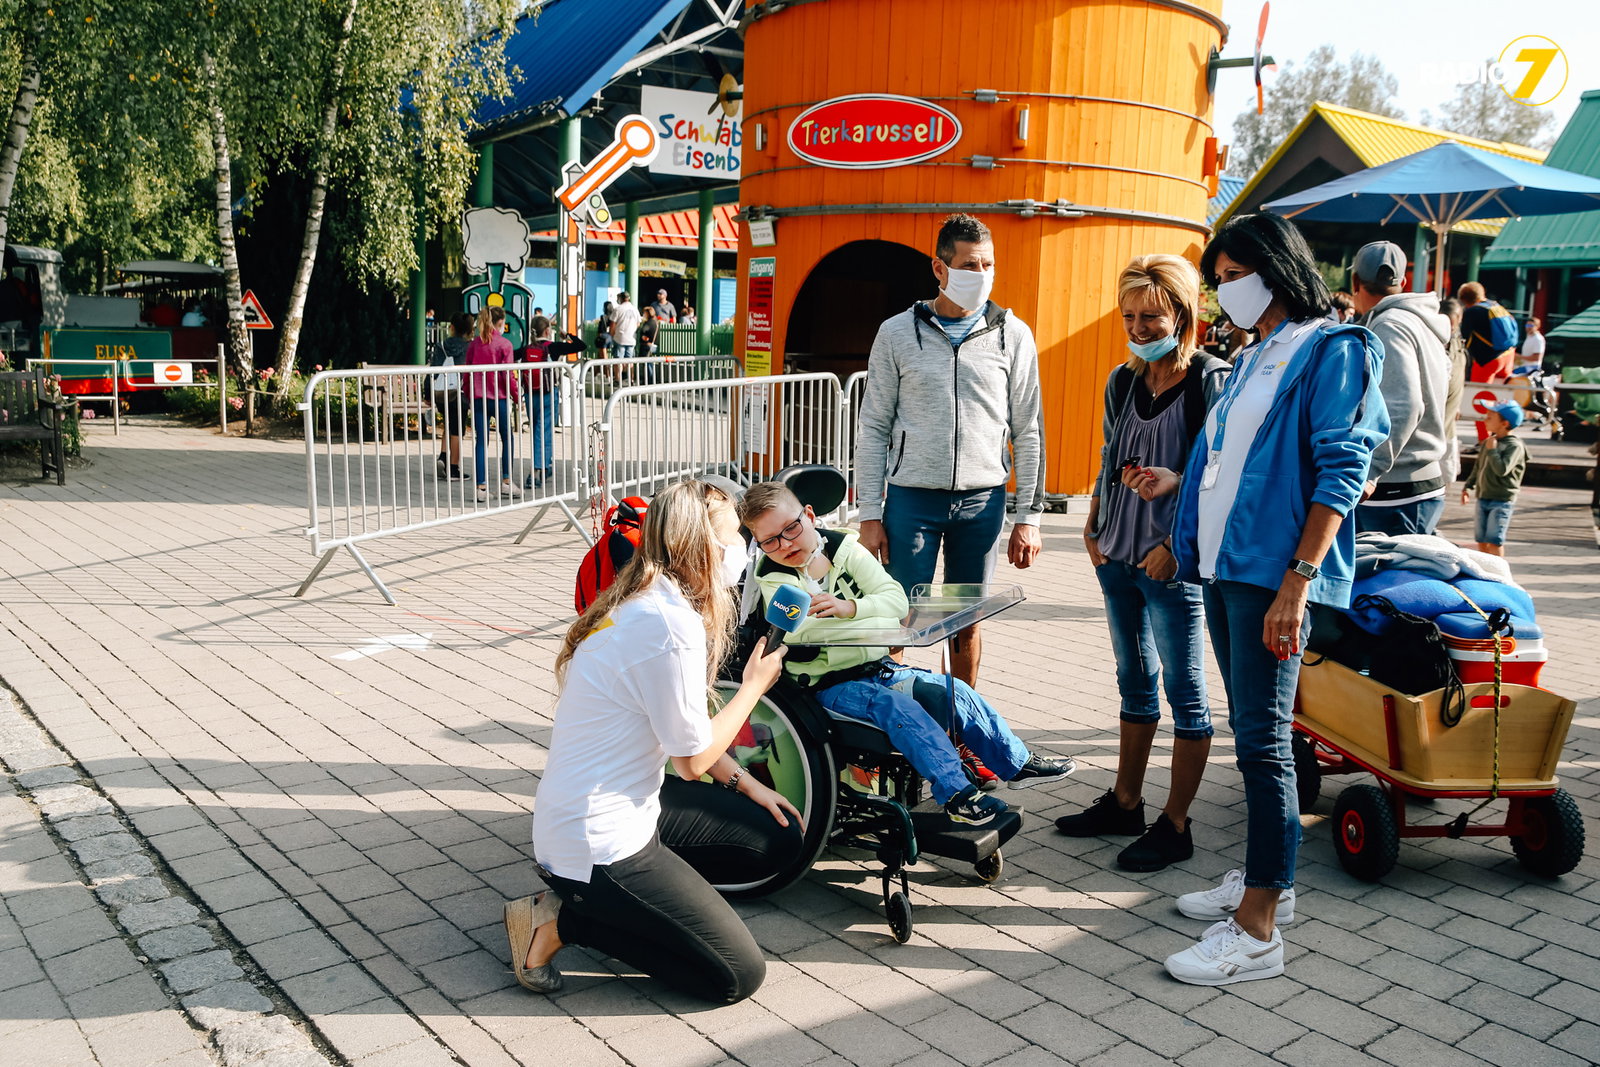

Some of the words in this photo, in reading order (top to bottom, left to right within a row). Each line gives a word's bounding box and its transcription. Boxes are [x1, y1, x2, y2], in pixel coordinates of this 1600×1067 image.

[801, 116, 943, 147] Tierkarussell
[673, 141, 741, 172] Eisenb
[750, 260, 774, 277] Eingang
[95, 345, 138, 360] ELISA
[773, 600, 790, 613] RADIO
